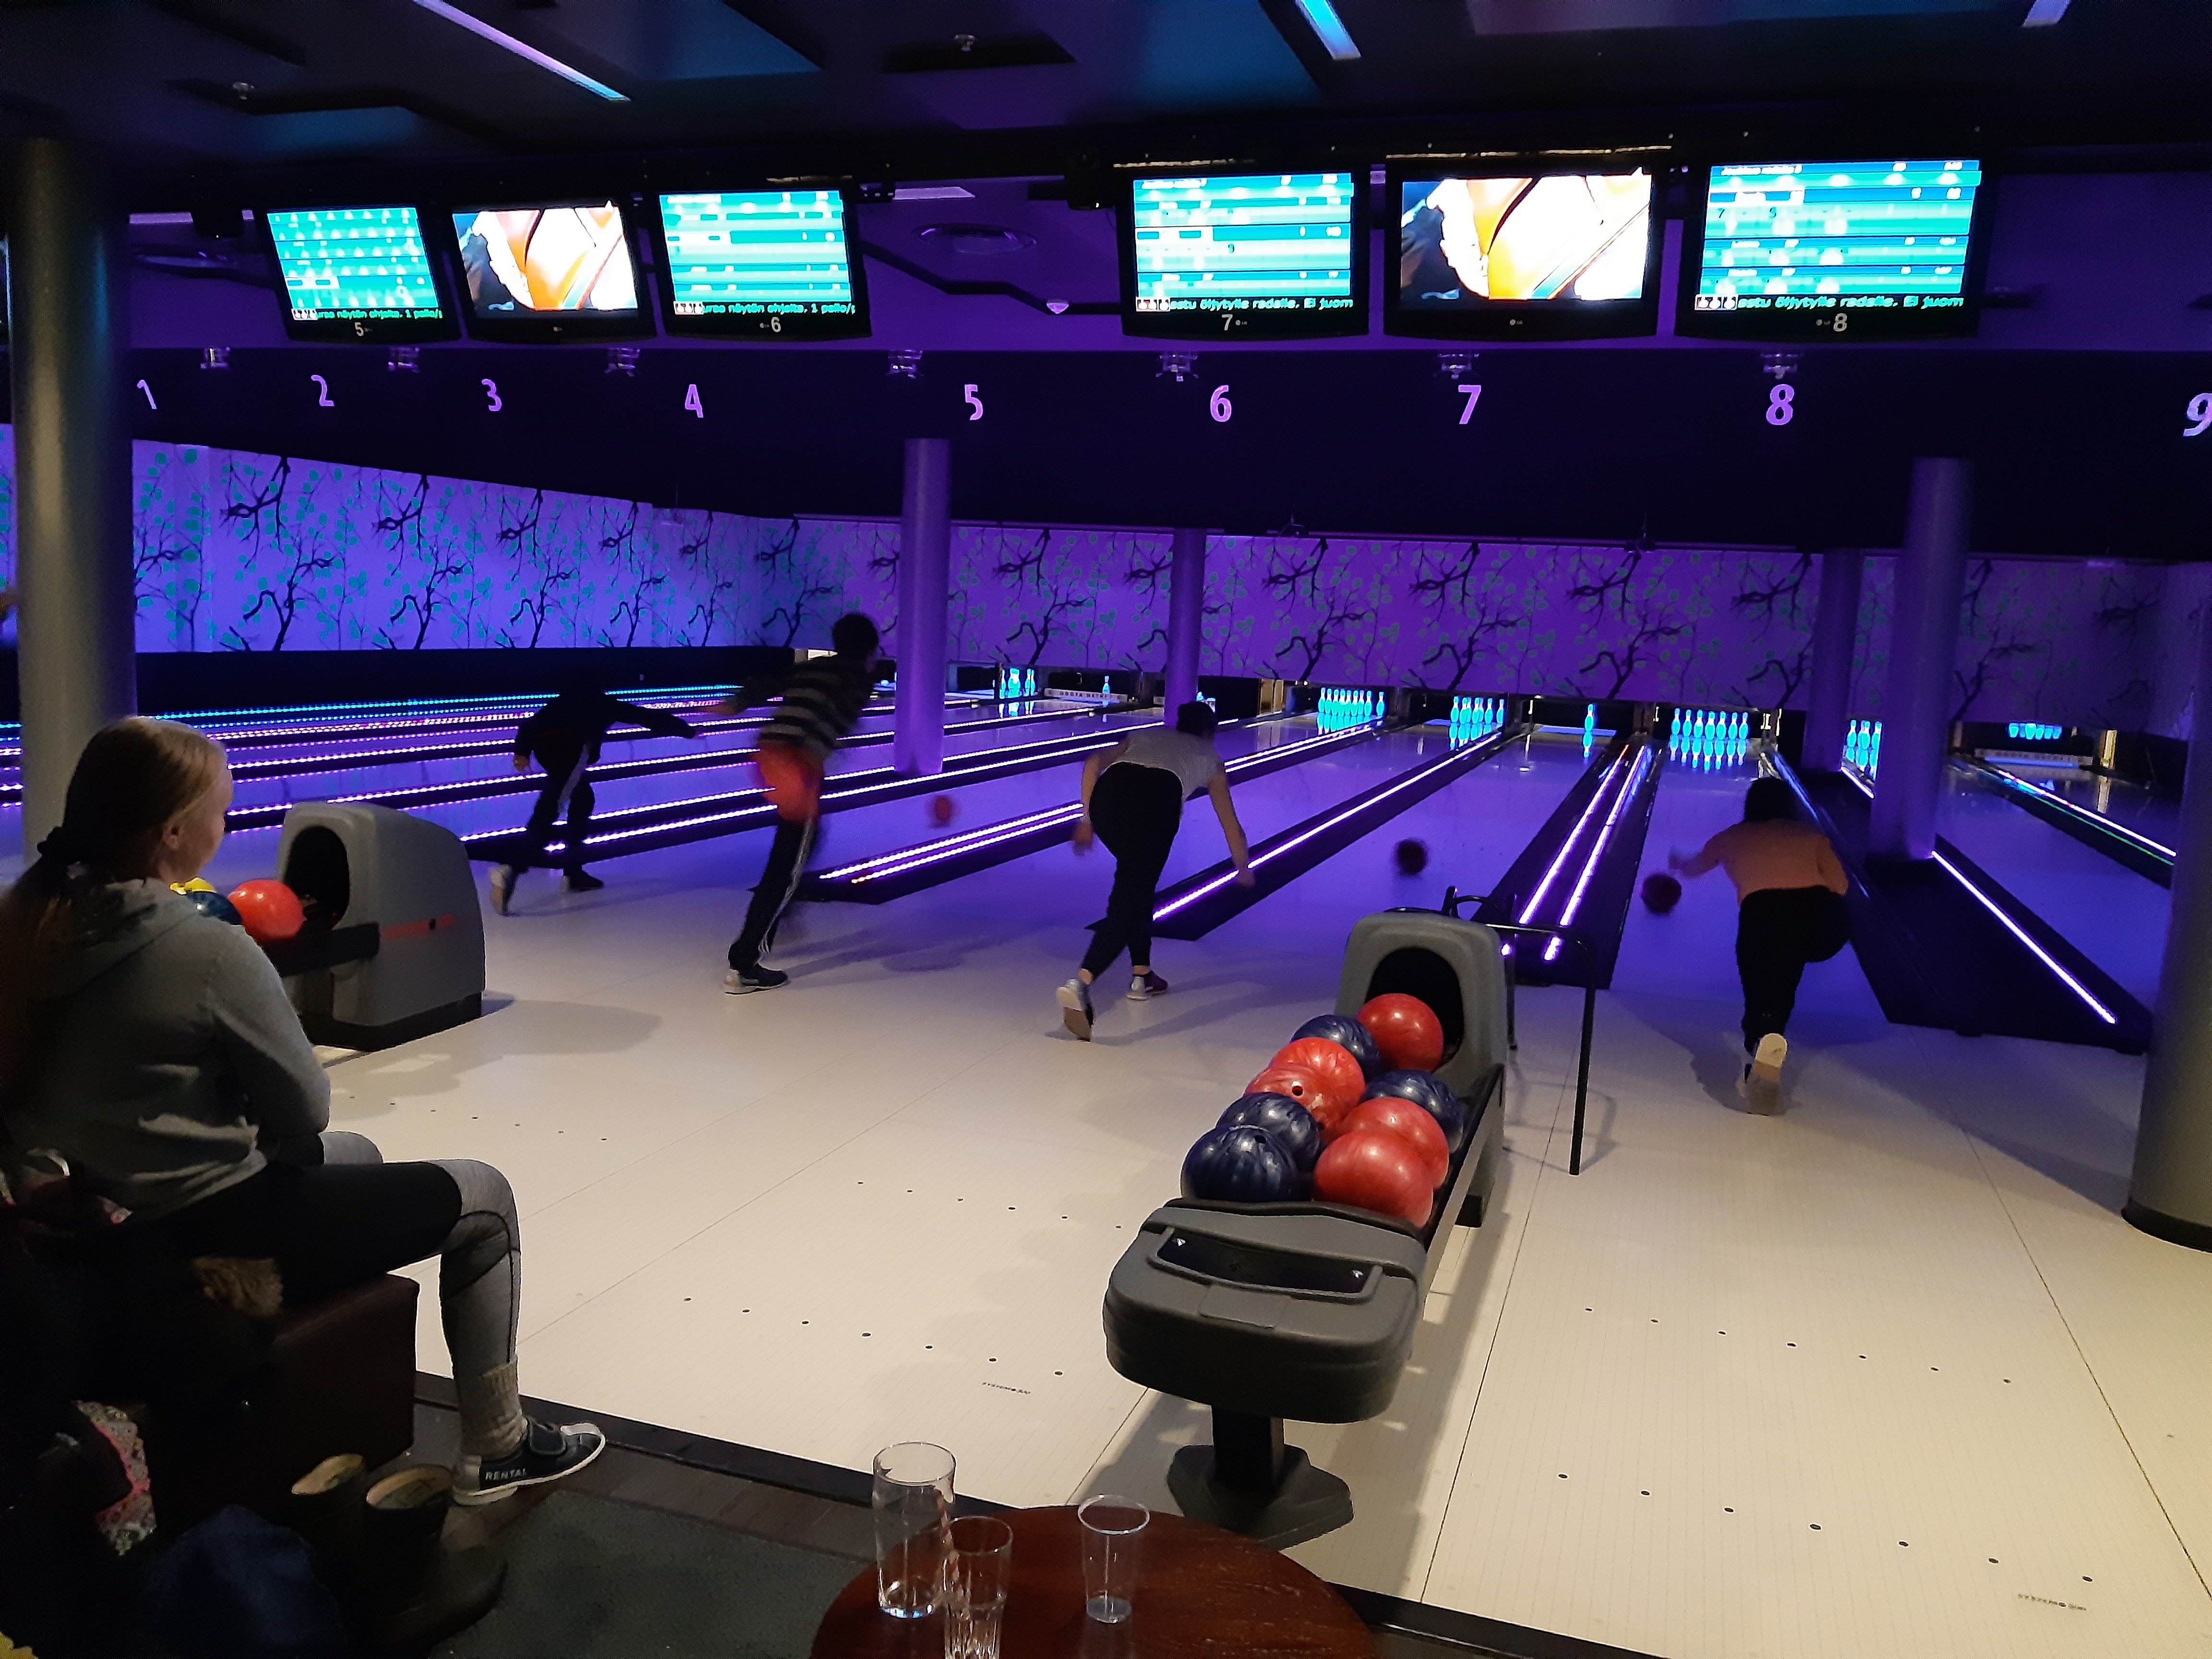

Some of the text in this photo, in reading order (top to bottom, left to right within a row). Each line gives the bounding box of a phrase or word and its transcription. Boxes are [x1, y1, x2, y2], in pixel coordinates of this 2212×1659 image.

[354, 322, 364, 337] 5
[771, 316, 781, 333] 6
[1221, 314, 1233, 331] 7
[1833, 313, 1847, 332] 8
[137, 379, 157, 409] 1
[311, 374, 335, 407] 2
[481, 378, 502, 412] 3
[685, 384, 704, 418] 4
[964, 384, 984, 421] 5
[1210, 385, 1232, 422] 6
[1458, 384, 1481, 425] 7
[1766, 384, 1795, 425] 8
[2183, 393, 2212, 437] 9
[485, 1467, 527, 1480] RENTAL
